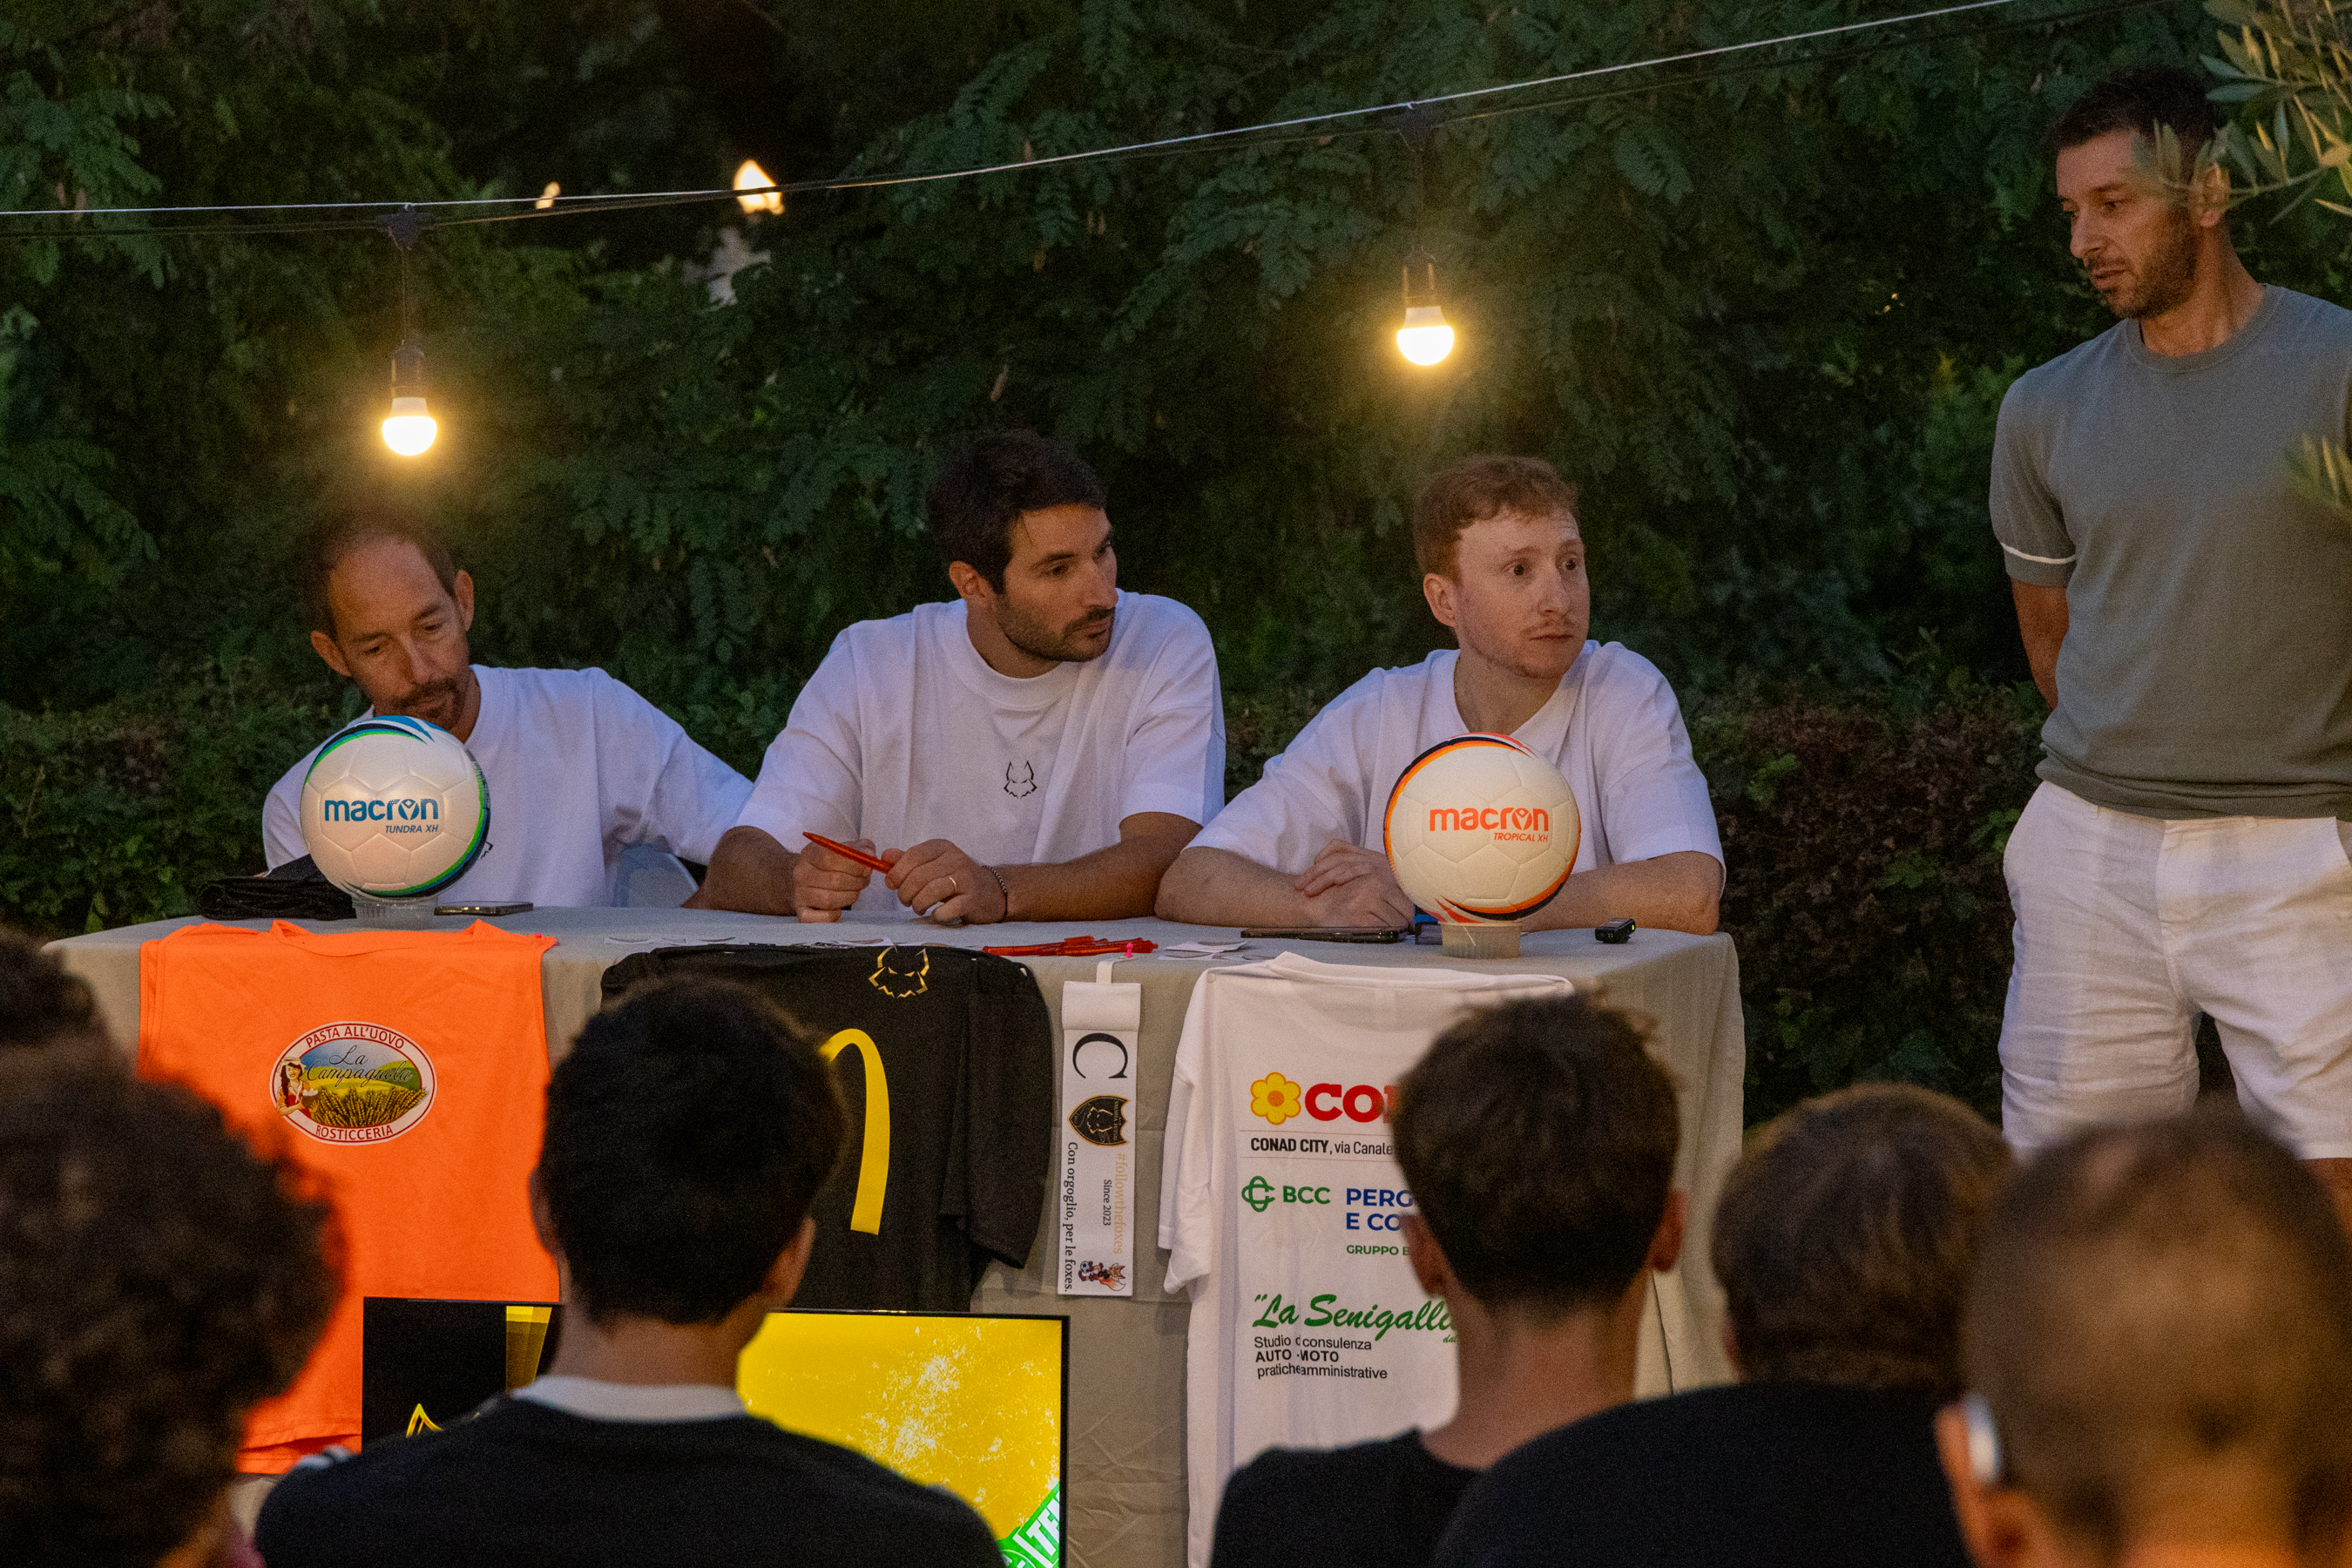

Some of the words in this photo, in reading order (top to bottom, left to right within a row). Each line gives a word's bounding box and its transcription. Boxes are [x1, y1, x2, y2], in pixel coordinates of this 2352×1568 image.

[324, 798, 439, 821] macron
[1429, 808, 1549, 831] macron
[385, 824, 422, 834] TUNDRA
[425, 824, 439, 833] XH
[1493, 832, 1536, 842] TROPICAL
[1538, 834, 1549, 842] XH
[306, 1027, 341, 1048] PASTA
[343, 1026, 404, 1049] ALL'UOVO
[328, 1044, 369, 1065] La
[307, 1060, 413, 1088] Campagnola
[316, 1125, 394, 1140] ROSTICCERIA
[1067, 1141, 1078, 1165] Con
[1250, 1138, 1296, 1152] CONAD
[1335, 1141, 1350, 1153] via
[1063, 1167, 1078, 1220] orgoglio,
[1103, 1179, 1112, 1203] Since
[1282, 1185, 1331, 1205] BCC
[1113, 1152, 1128, 1254] #followthefoxes
[1102, 1205, 1112, 1227] 2023
[1346, 1213, 1360, 1230] E
[1062, 1223, 1073, 1243] per
[1064, 1245, 1076, 1256] le
[1346, 1244, 1399, 1256] GRUPPO
[1064, 1258, 1077, 1293] foxes.
[1254, 1335, 1291, 1348] Studio
[1302, 1337, 1372, 1350] consulenza
[1255, 1348, 1292, 1362] AUTO
[1301, 1365, 1388, 1379] amministrative
